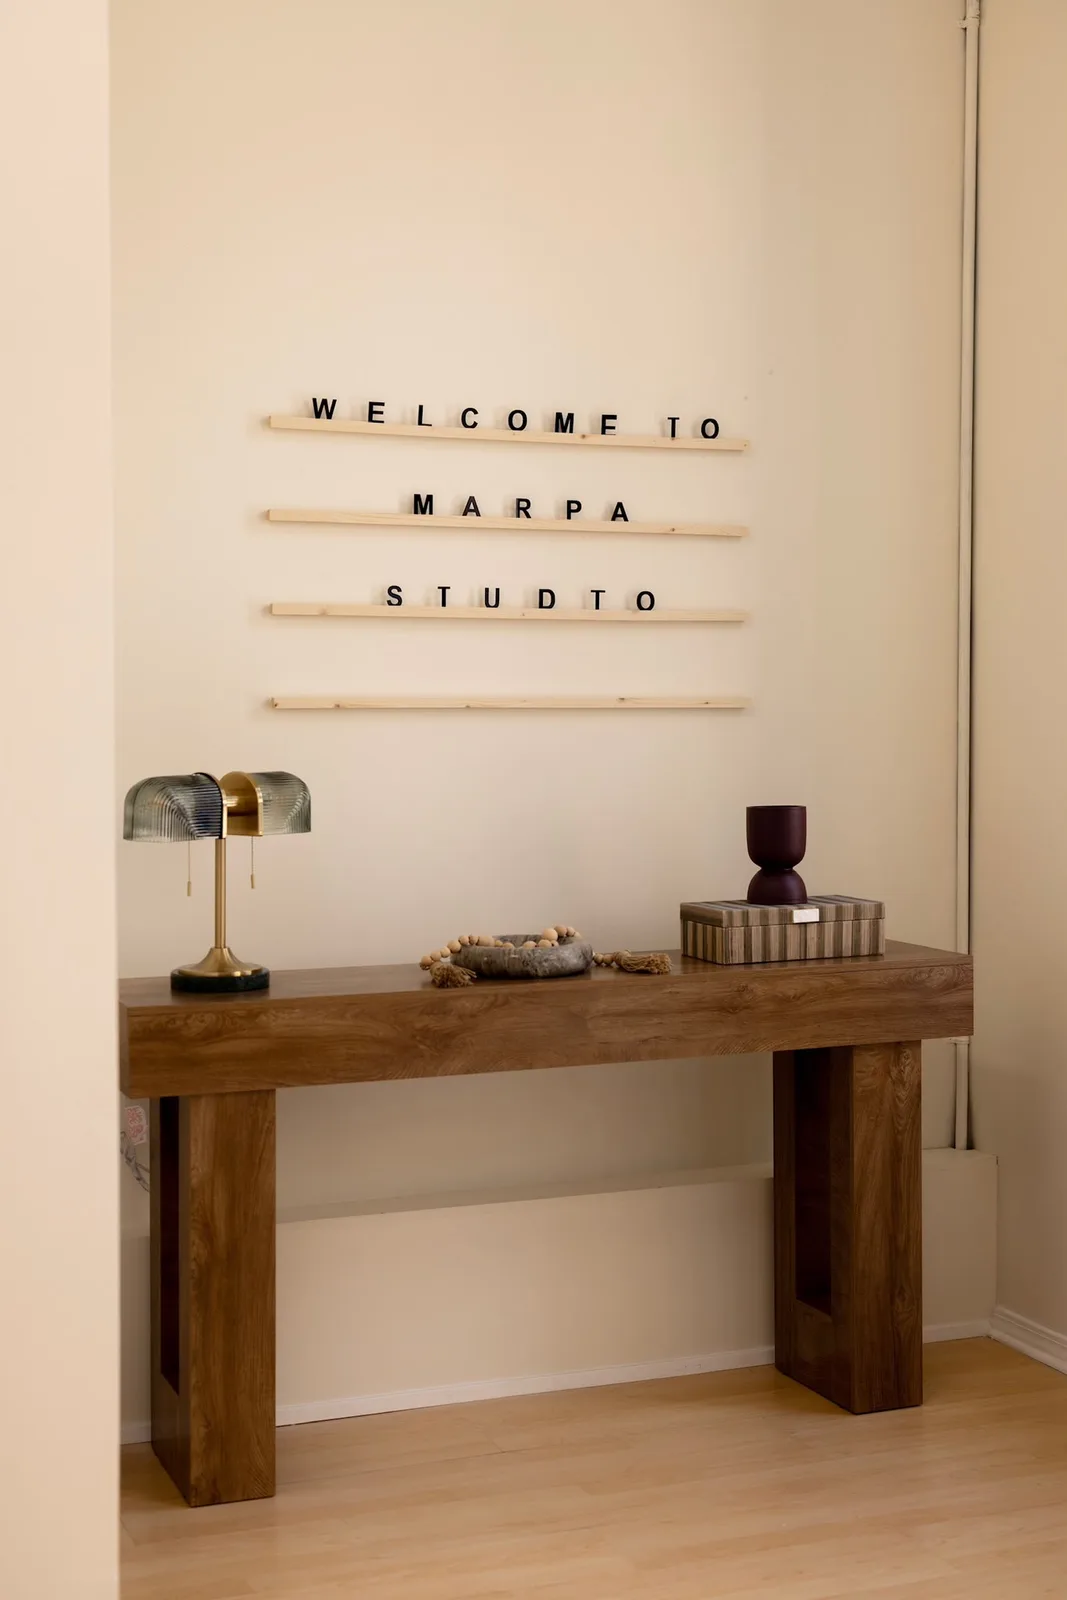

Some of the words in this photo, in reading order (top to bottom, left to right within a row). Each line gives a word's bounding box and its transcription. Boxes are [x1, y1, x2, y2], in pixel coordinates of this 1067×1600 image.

[312, 397, 618, 436] WELCOME
[667, 416, 720, 440] TO
[413, 493, 629, 522] MARPA
